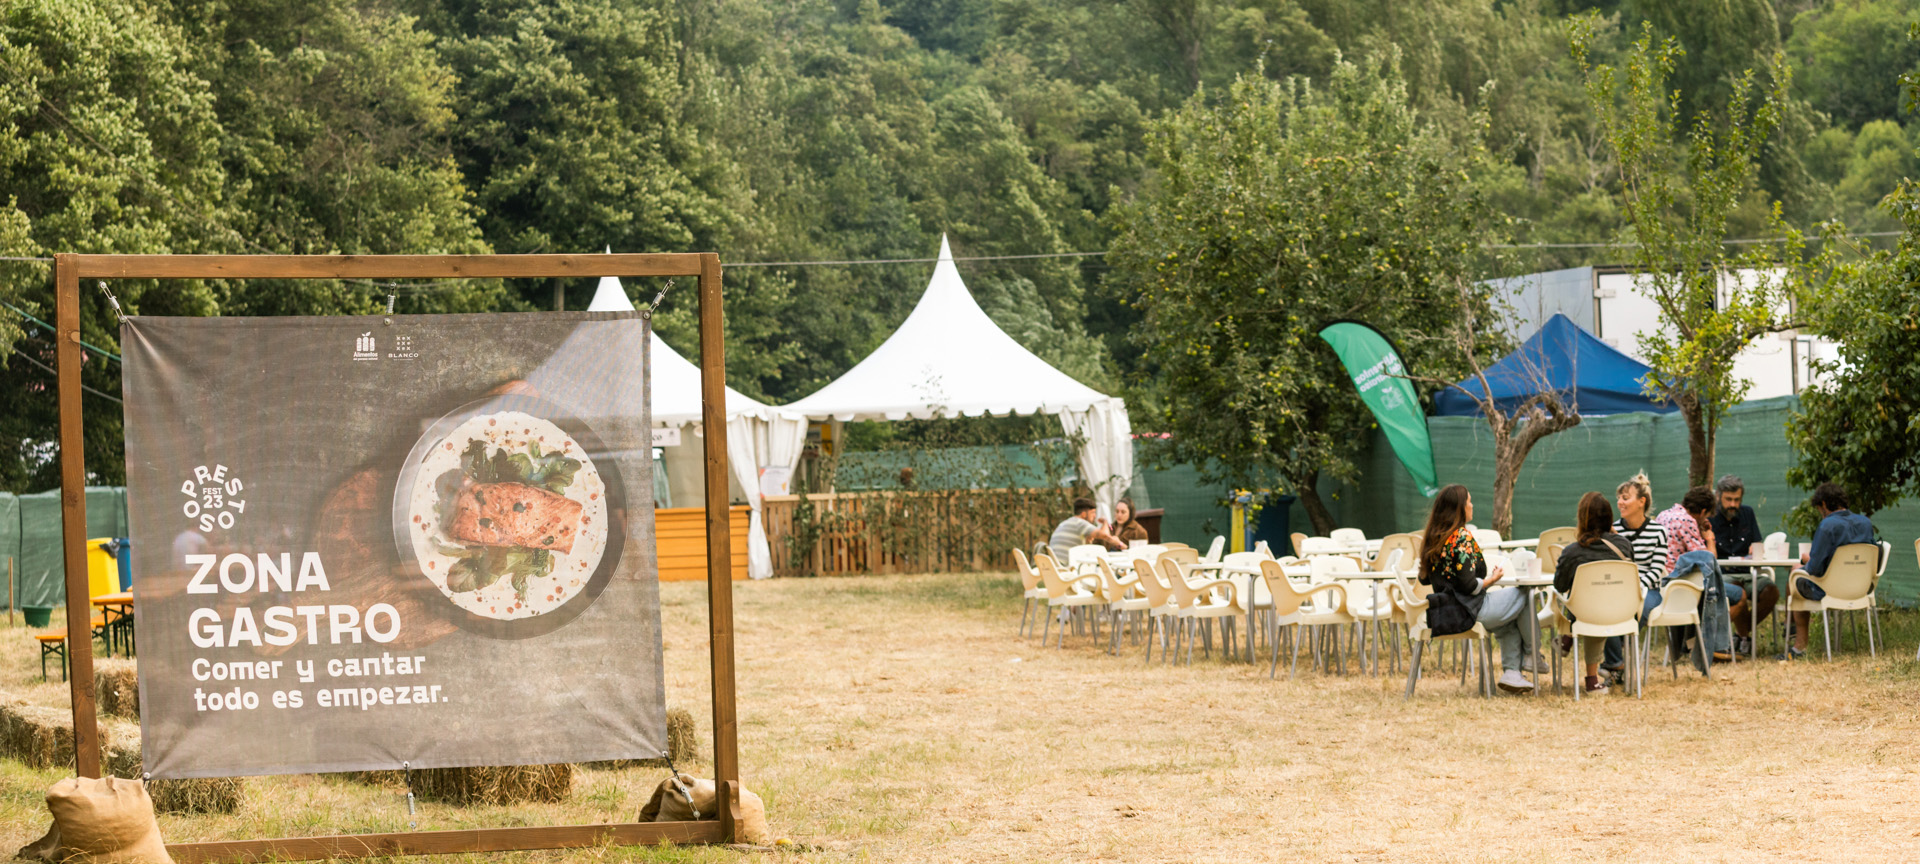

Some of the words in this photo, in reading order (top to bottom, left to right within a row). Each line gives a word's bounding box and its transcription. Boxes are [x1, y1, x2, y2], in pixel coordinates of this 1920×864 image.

[203, 495, 224, 508] 23
[185, 551, 331, 594] ZONA
[188, 602, 401, 648] GASTRO
[191, 657, 283, 681] Comer
[296, 659, 315, 683] y
[327, 652, 426, 677] cantar
[194, 686, 259, 711] todo
[272, 689, 304, 709] es
[316, 684, 449, 710] empezar.
